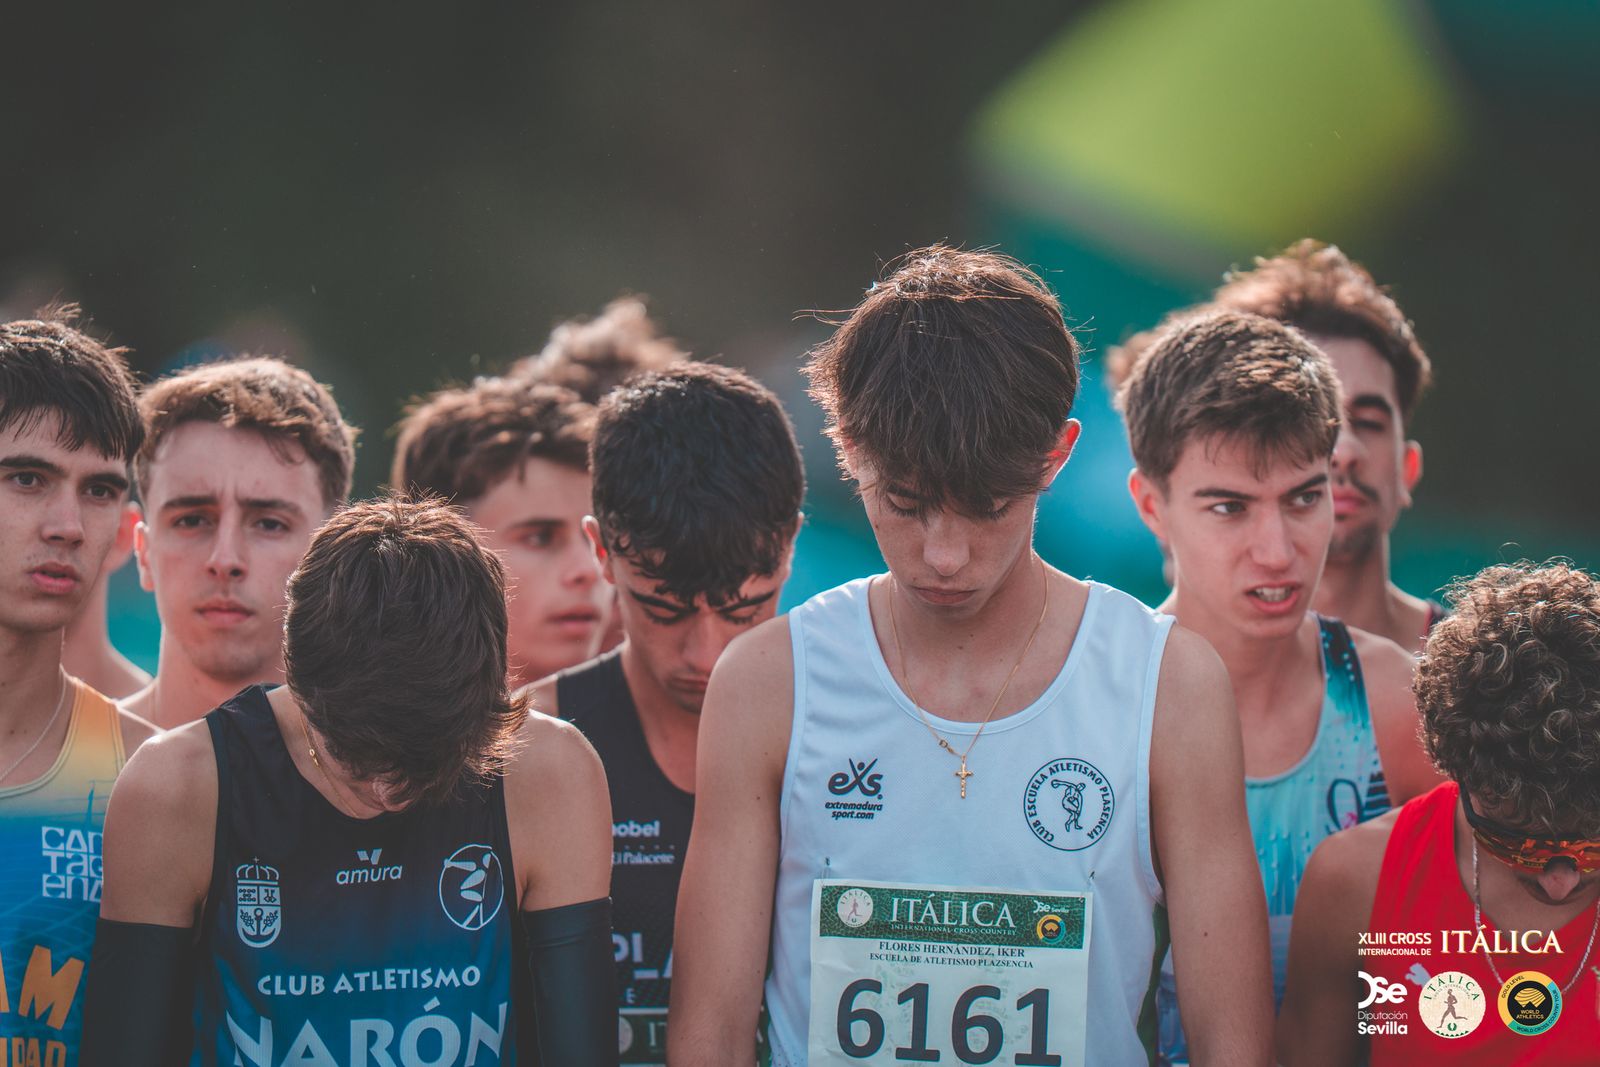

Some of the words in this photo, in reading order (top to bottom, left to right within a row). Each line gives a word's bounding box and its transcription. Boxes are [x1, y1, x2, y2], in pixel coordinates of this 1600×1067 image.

[1048, 763, 1103, 786] ATLETISMO
[824, 801, 883, 811] extremadura
[1027, 773, 1049, 818] ESCUELA
[831, 811, 875, 821] sport.com
[1086, 785, 1111, 840] PLASENCIA
[1032, 820, 1055, 842] CLUB
[336, 864, 403, 885] amura
[891, 893, 1016, 928] ITÁLICA
[953, 927, 978, 935] CROSS
[980, 928, 1016, 936] COUNTRY
[880, 941, 920, 953] FLORES
[997, 947, 1025, 958] IKER
[869, 953, 908, 963] ESCUELA
[910, 955, 922, 964] DE
[925, 956, 976, 967] ATLETISMO
[978, 958, 1034, 969] PLAZSENCIA
[257, 975, 325, 996] CLUB
[333, 965, 481, 995] ATLETISMO
[226, 996, 508, 1067] NARÓN
[836, 978, 1062, 1067] 6161
